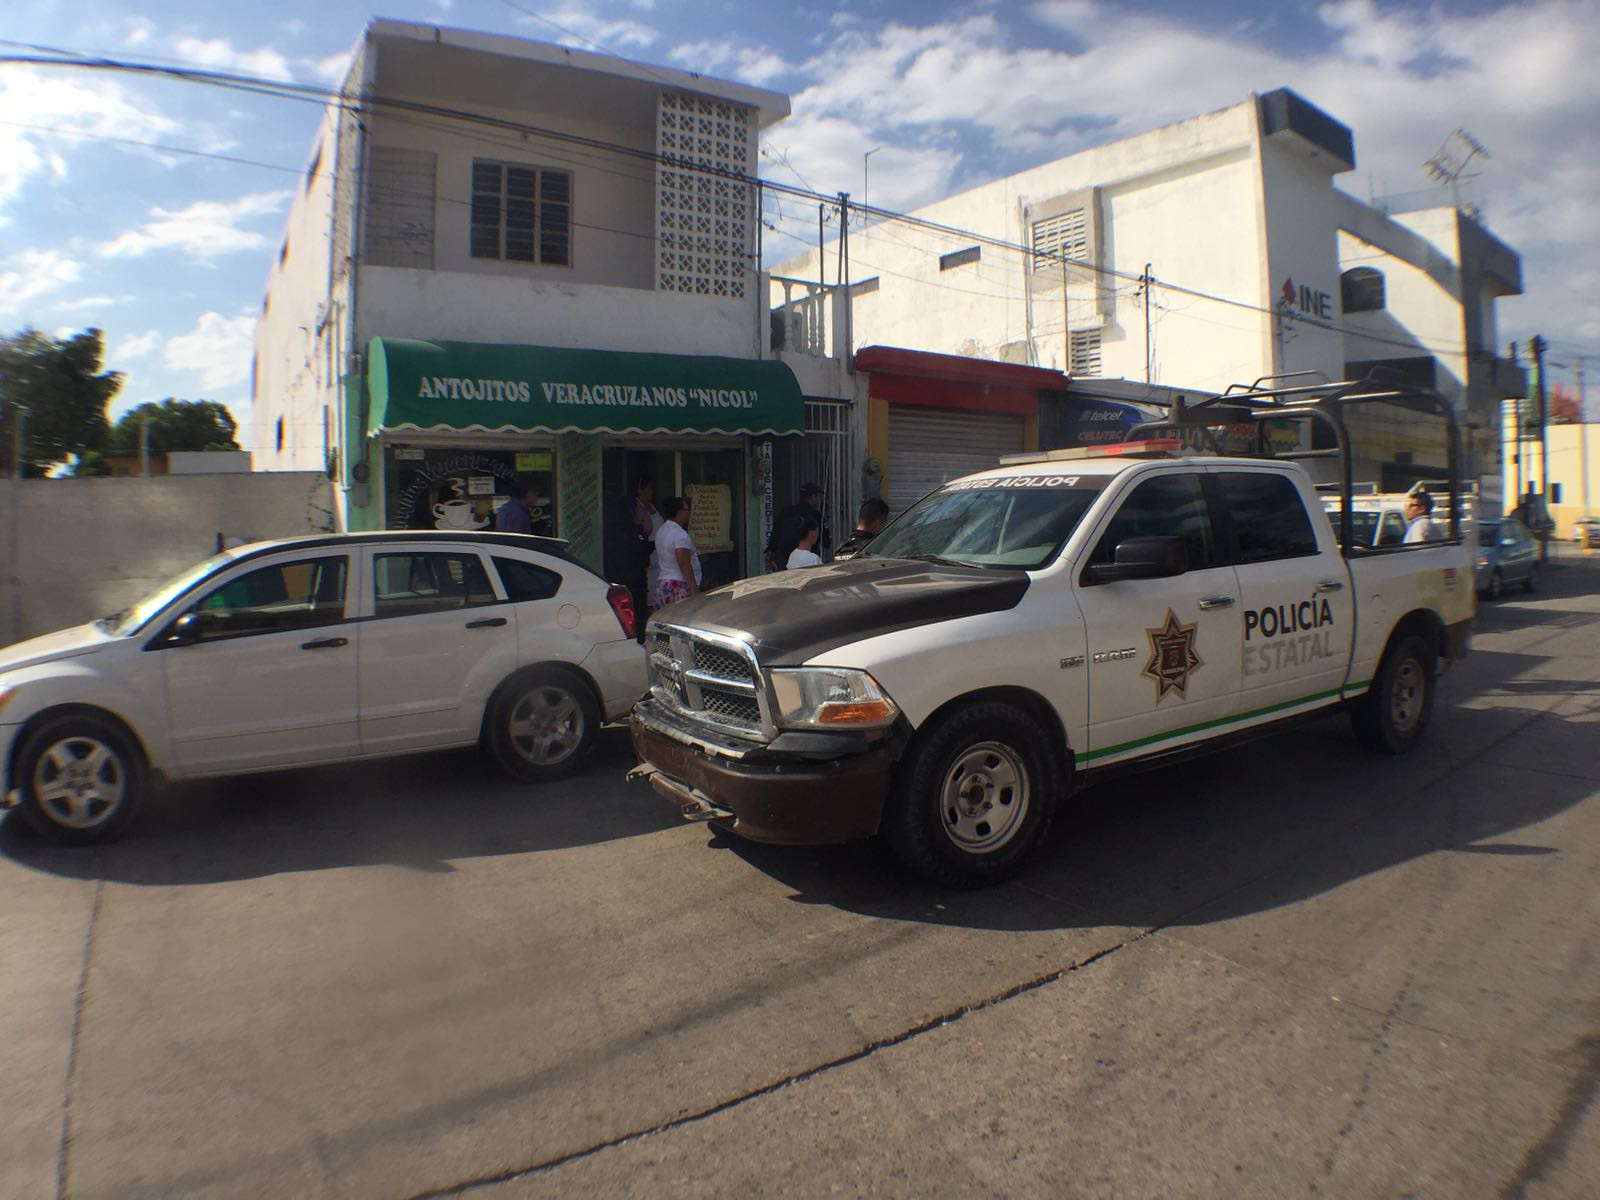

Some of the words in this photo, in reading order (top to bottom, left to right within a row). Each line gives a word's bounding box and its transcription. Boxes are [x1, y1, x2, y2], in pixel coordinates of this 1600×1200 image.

[1299, 285, 1332, 320] INE
[419, 376, 531, 403] ANTOJITOS
[541, 382, 688, 407] VERACRUZANOS
[1090, 409, 1122, 421] telcel
[1244, 593, 1333, 641] POLICÍA
[1244, 630, 1335, 676] ESTATAL
